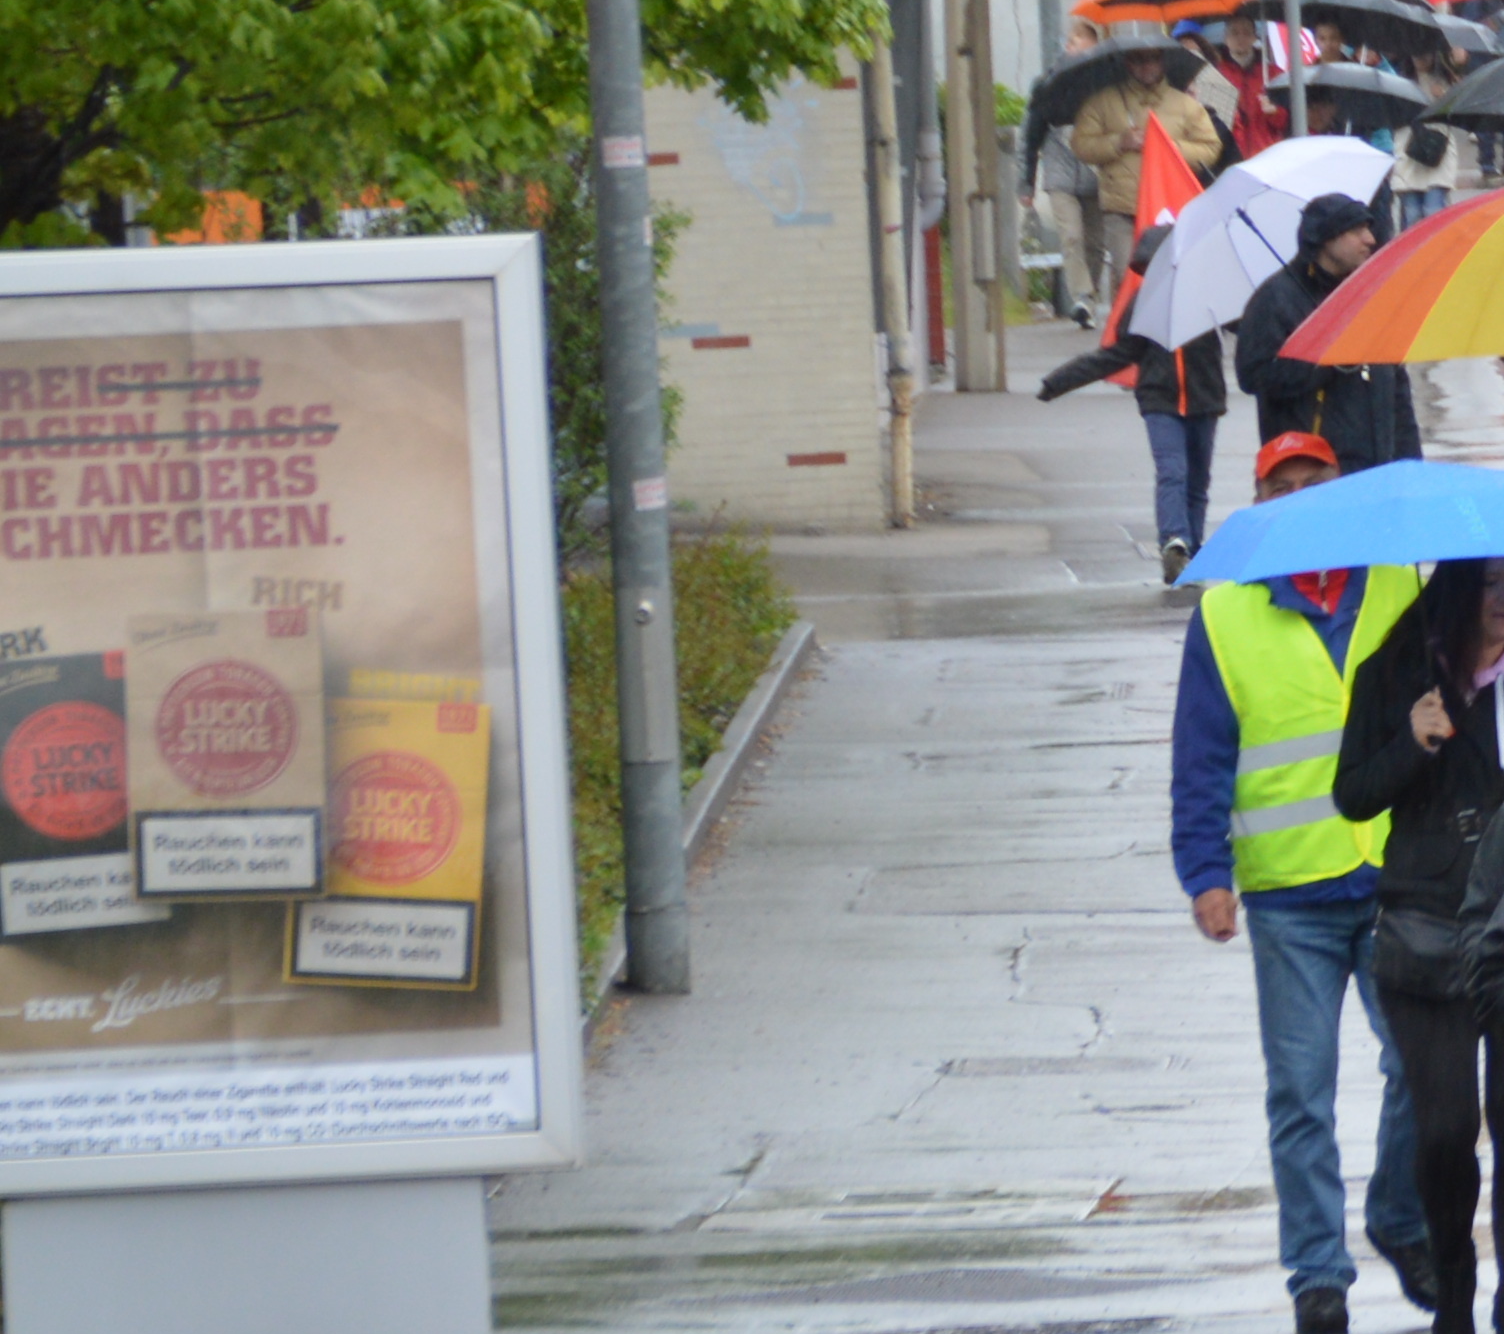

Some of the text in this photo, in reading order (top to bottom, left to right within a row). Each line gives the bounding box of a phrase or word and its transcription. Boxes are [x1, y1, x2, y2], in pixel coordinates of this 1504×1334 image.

[76, 454, 320, 507] ANDERS
[183, 700, 271, 727] LUCKY
[178, 727, 273, 754] STRIKE
[32, 743, 114, 769] LUCKY
[30, 768, 121, 798] STRIKE
[351, 788, 435, 814] LUCKY
[343, 817, 435, 843] STRIKE
